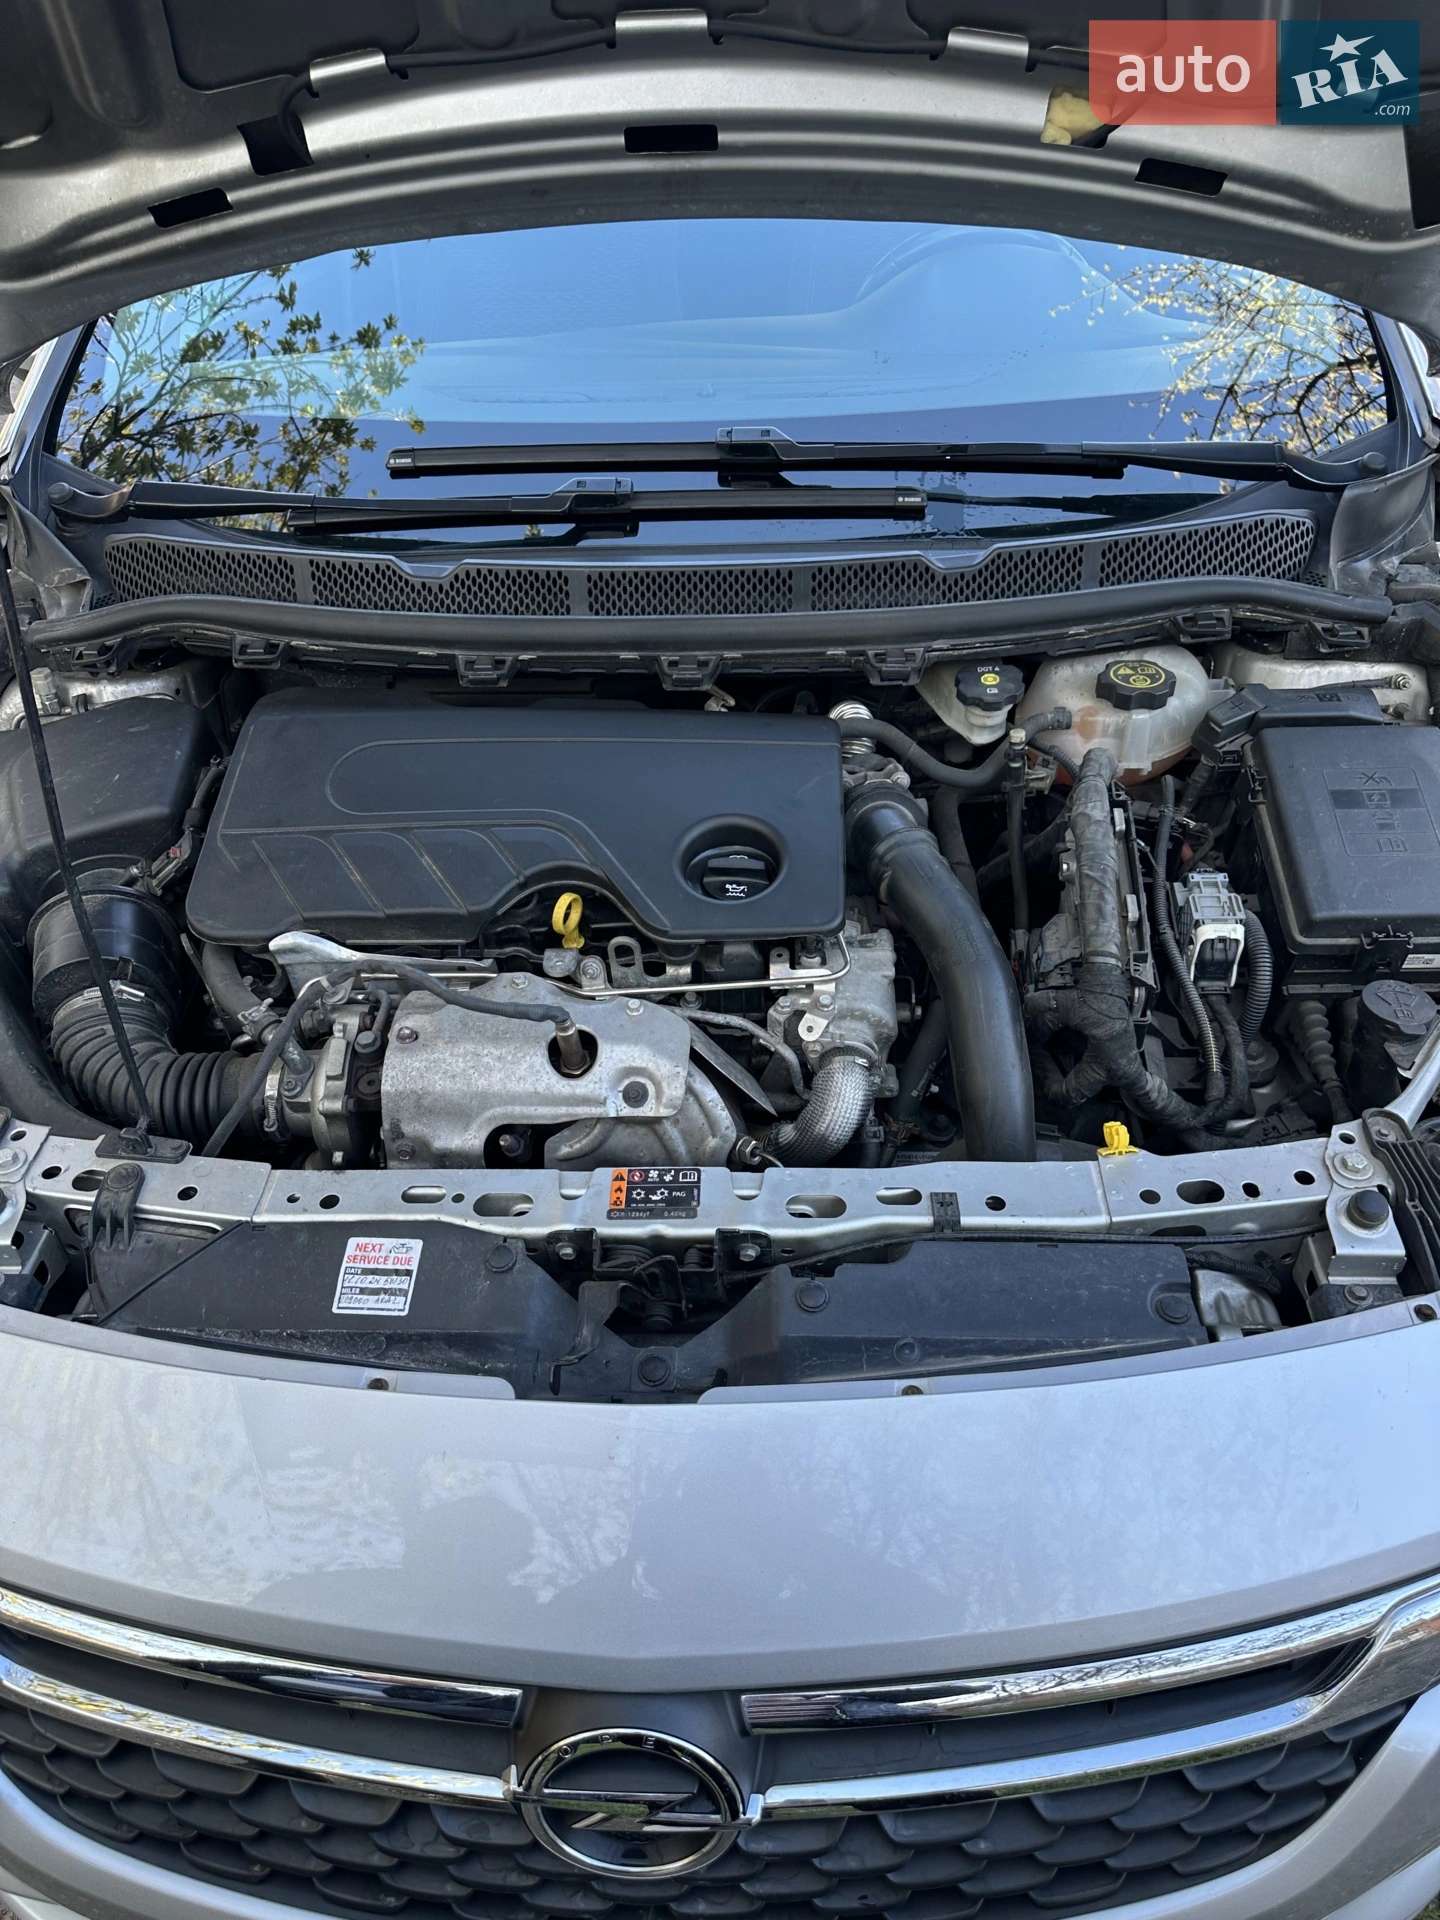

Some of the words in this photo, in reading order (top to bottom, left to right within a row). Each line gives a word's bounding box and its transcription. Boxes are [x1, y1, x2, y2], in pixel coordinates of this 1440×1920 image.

[355, 1243, 384, 1253] NEXT
[346, 1255, 390, 1265] SERVICE
[392, 1256, 414, 1266] DUE
[558, 1734, 692, 1762] OPEL
